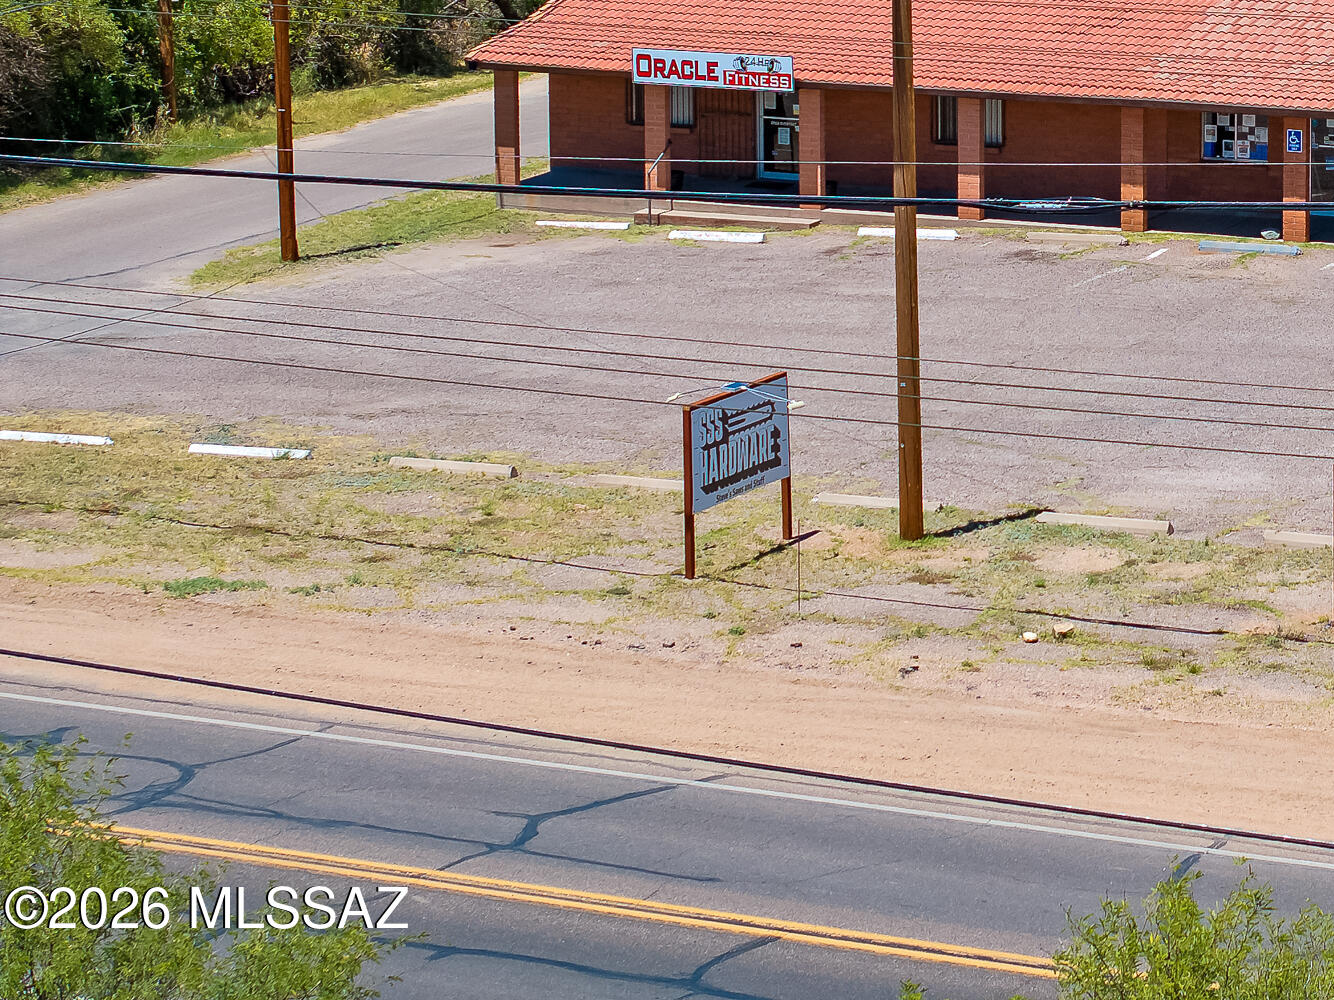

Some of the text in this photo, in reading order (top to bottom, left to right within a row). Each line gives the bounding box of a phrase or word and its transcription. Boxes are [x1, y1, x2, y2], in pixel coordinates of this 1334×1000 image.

[636, 54, 719, 82] ORACLE
[725, 71, 789, 88] FITNESS
[699, 407, 723, 448] SSS
[702, 424, 776, 486] HARDWARE
